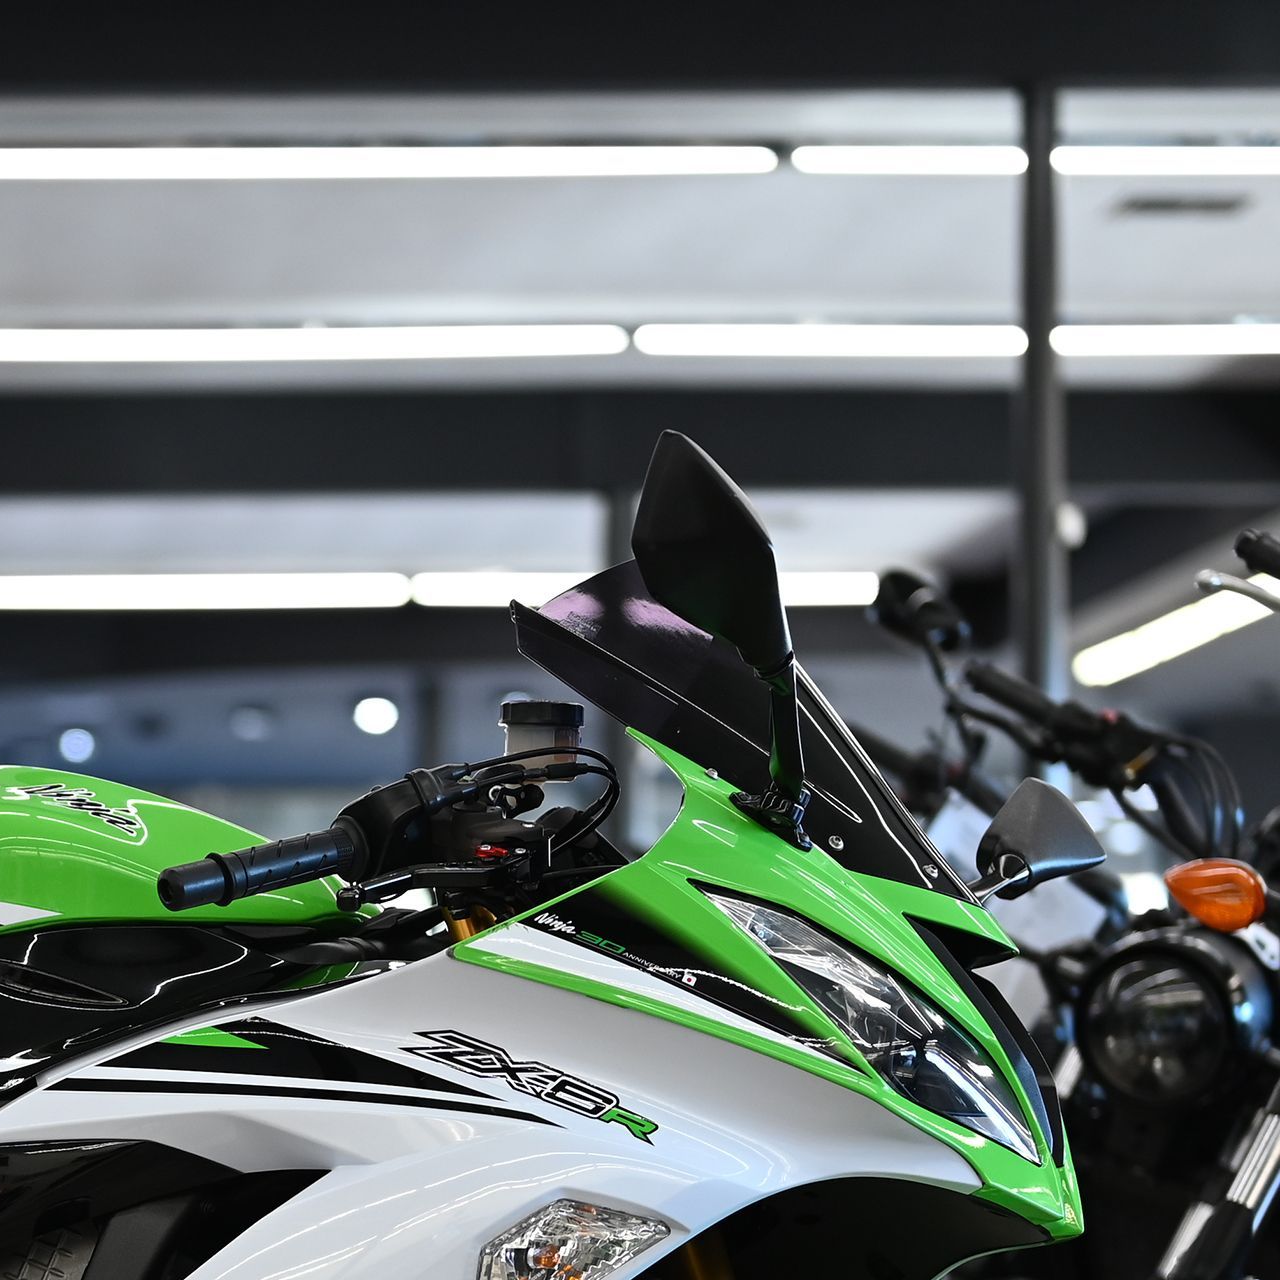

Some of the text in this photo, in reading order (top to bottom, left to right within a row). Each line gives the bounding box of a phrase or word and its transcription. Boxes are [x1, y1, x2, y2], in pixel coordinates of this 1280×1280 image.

[17, 784, 140, 836] Ninja
[534, 912, 576, 934] Ninja
[576, 930, 626, 954] 30
